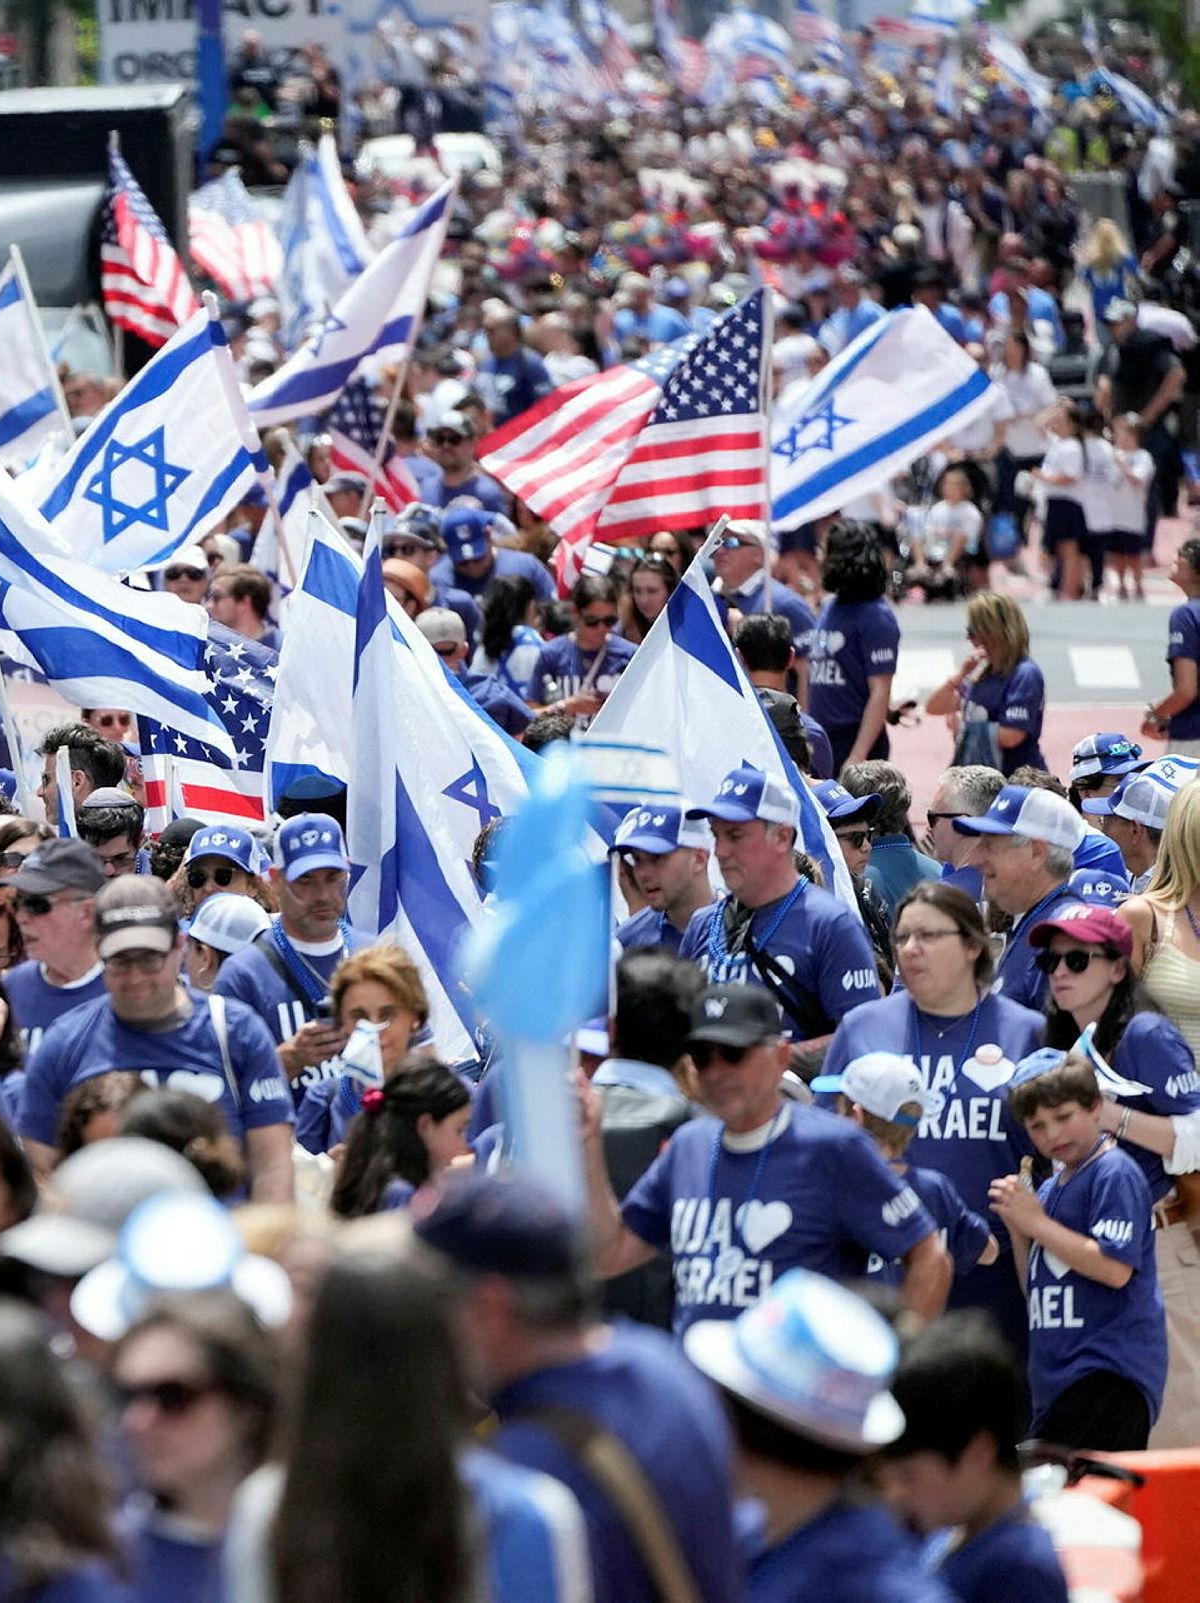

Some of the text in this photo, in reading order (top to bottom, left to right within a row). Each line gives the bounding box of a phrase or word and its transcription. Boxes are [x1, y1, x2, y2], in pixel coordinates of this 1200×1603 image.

[854, 968, 877, 990] UJA
[671, 1198, 731, 1255] UJA
[1105, 1218, 1134, 1243] UJA
